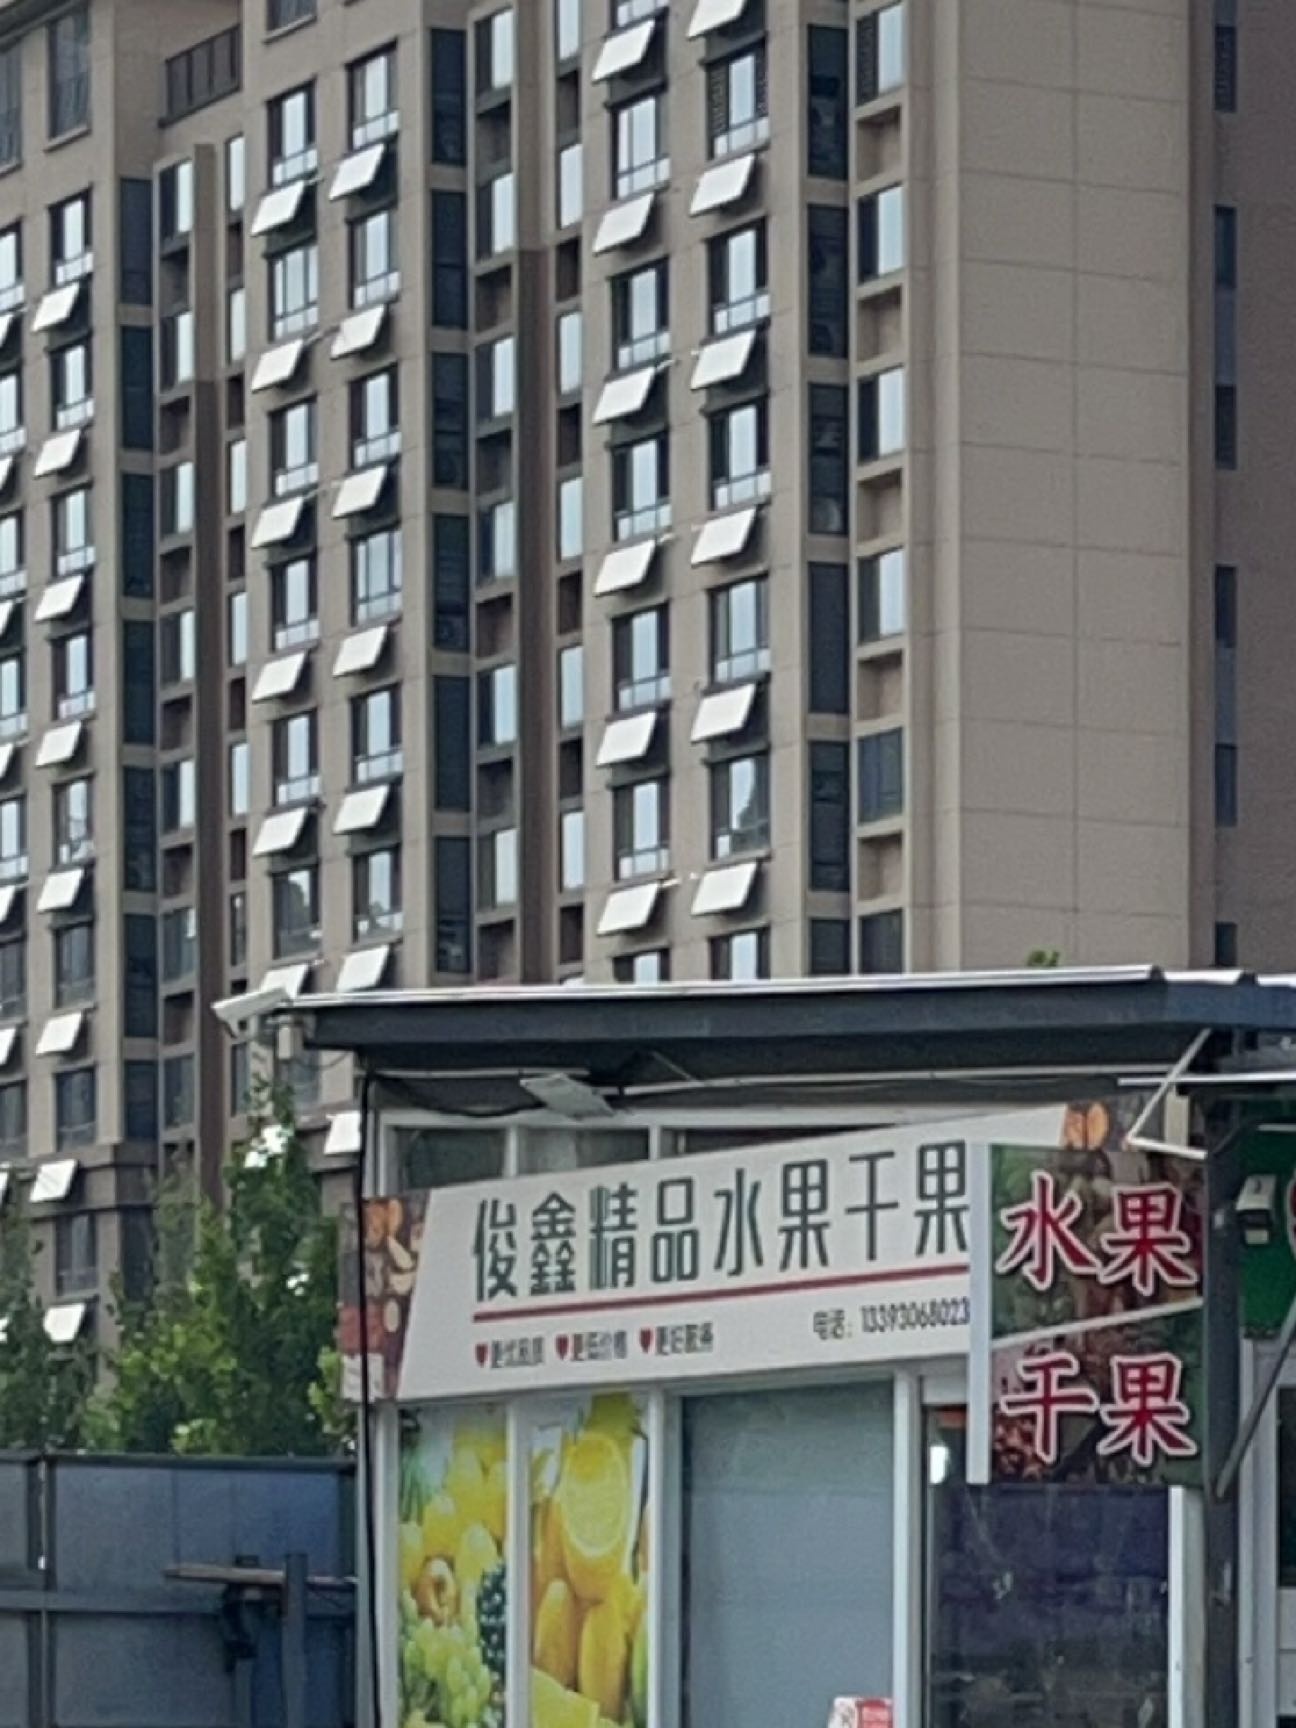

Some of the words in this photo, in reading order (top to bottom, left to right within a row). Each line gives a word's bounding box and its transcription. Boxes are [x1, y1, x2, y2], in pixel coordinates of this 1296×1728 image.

[473, 1139, 969, 1302] 俊鑫精品水果干果
[997, 1171, 1198, 1295] 水果
[1001, 1350, 1198, 1466] 干果
